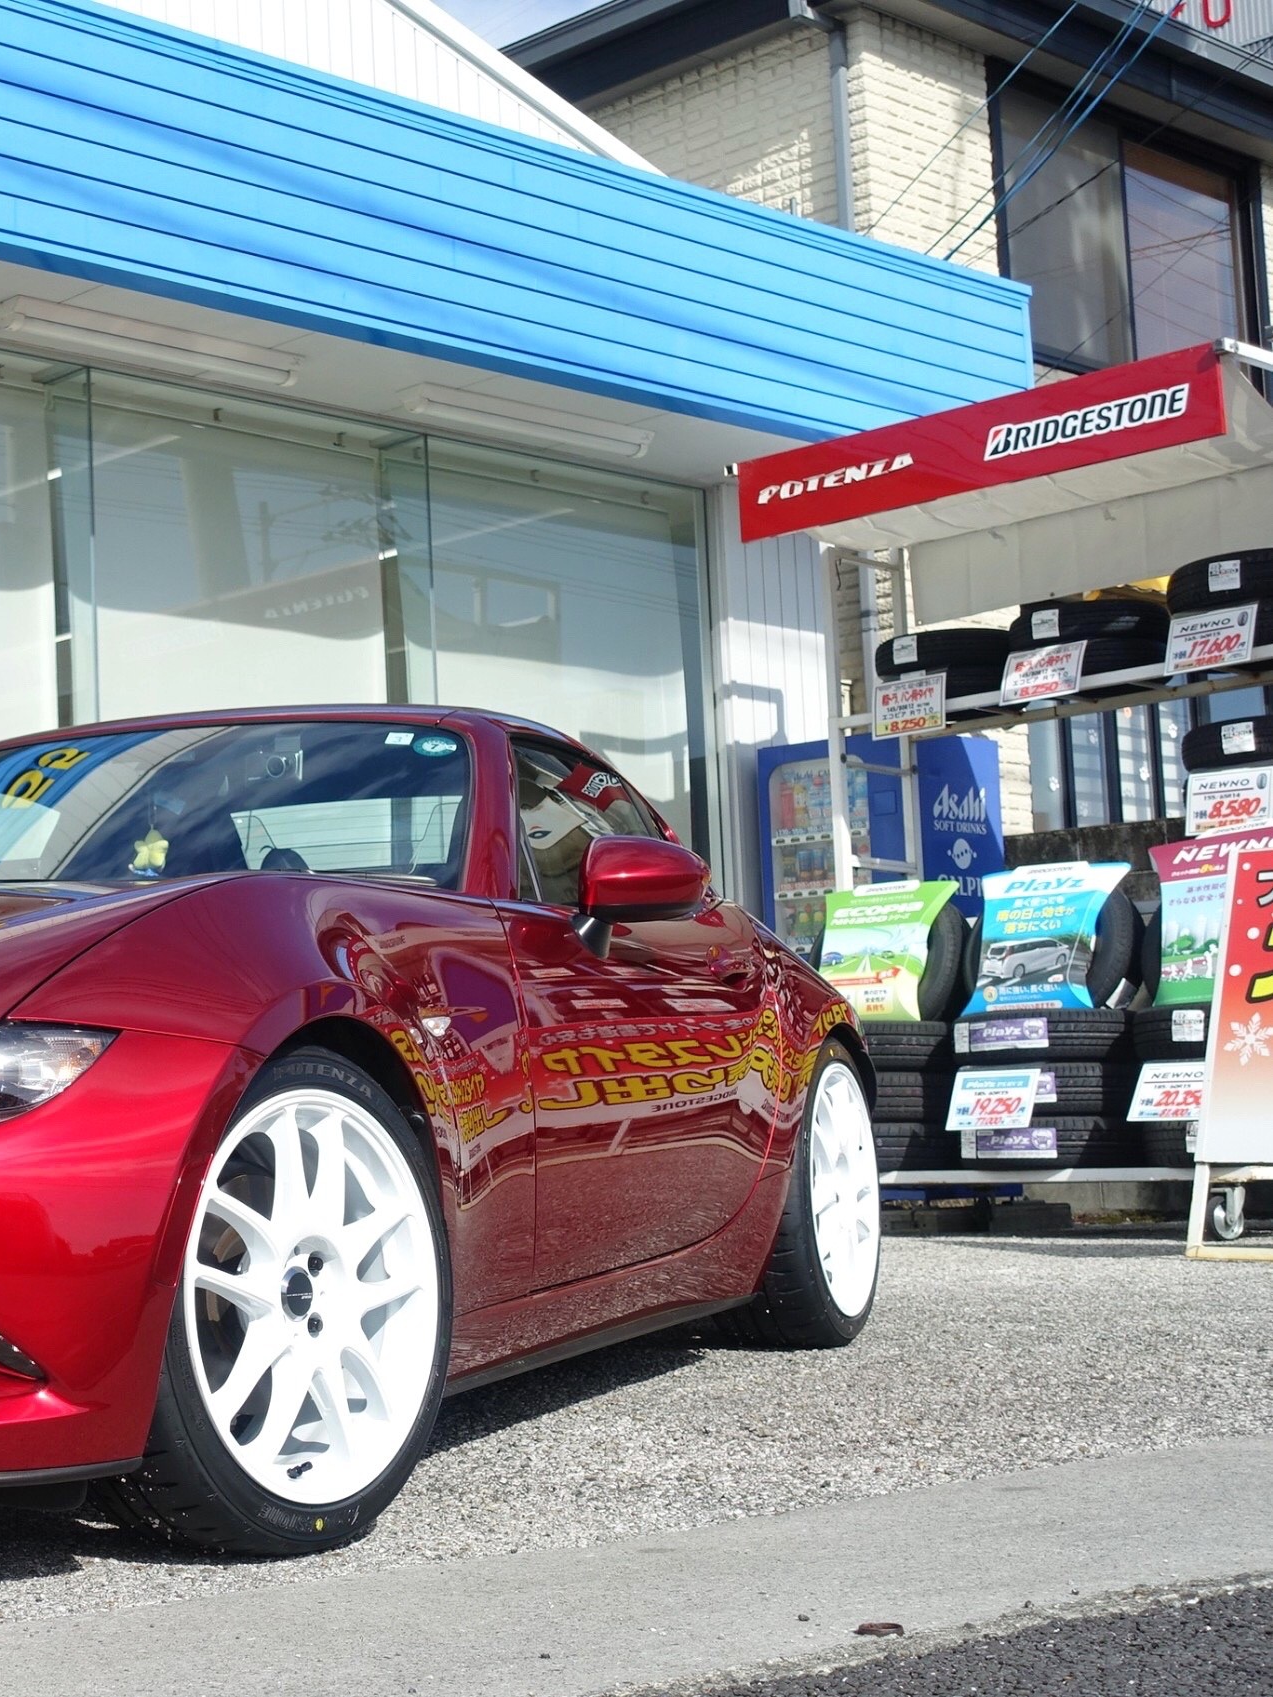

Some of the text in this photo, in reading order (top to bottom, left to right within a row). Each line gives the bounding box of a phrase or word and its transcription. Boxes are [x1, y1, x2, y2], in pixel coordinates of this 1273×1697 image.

[987, 386, 1186, 458] BRIDGESTONE
[757, 452, 914, 505] POTENZA
[1180, 618, 1231, 633] NEWNO
[1198, 778, 1250, 790] NEWNO
[933, 783, 986, 822] Asahi
[933, 819, 987, 835] SOFT DRINKS
[1172, 836, 1273, 865] NEWN
[1151, 1071, 1204, 1079] NEWNO
